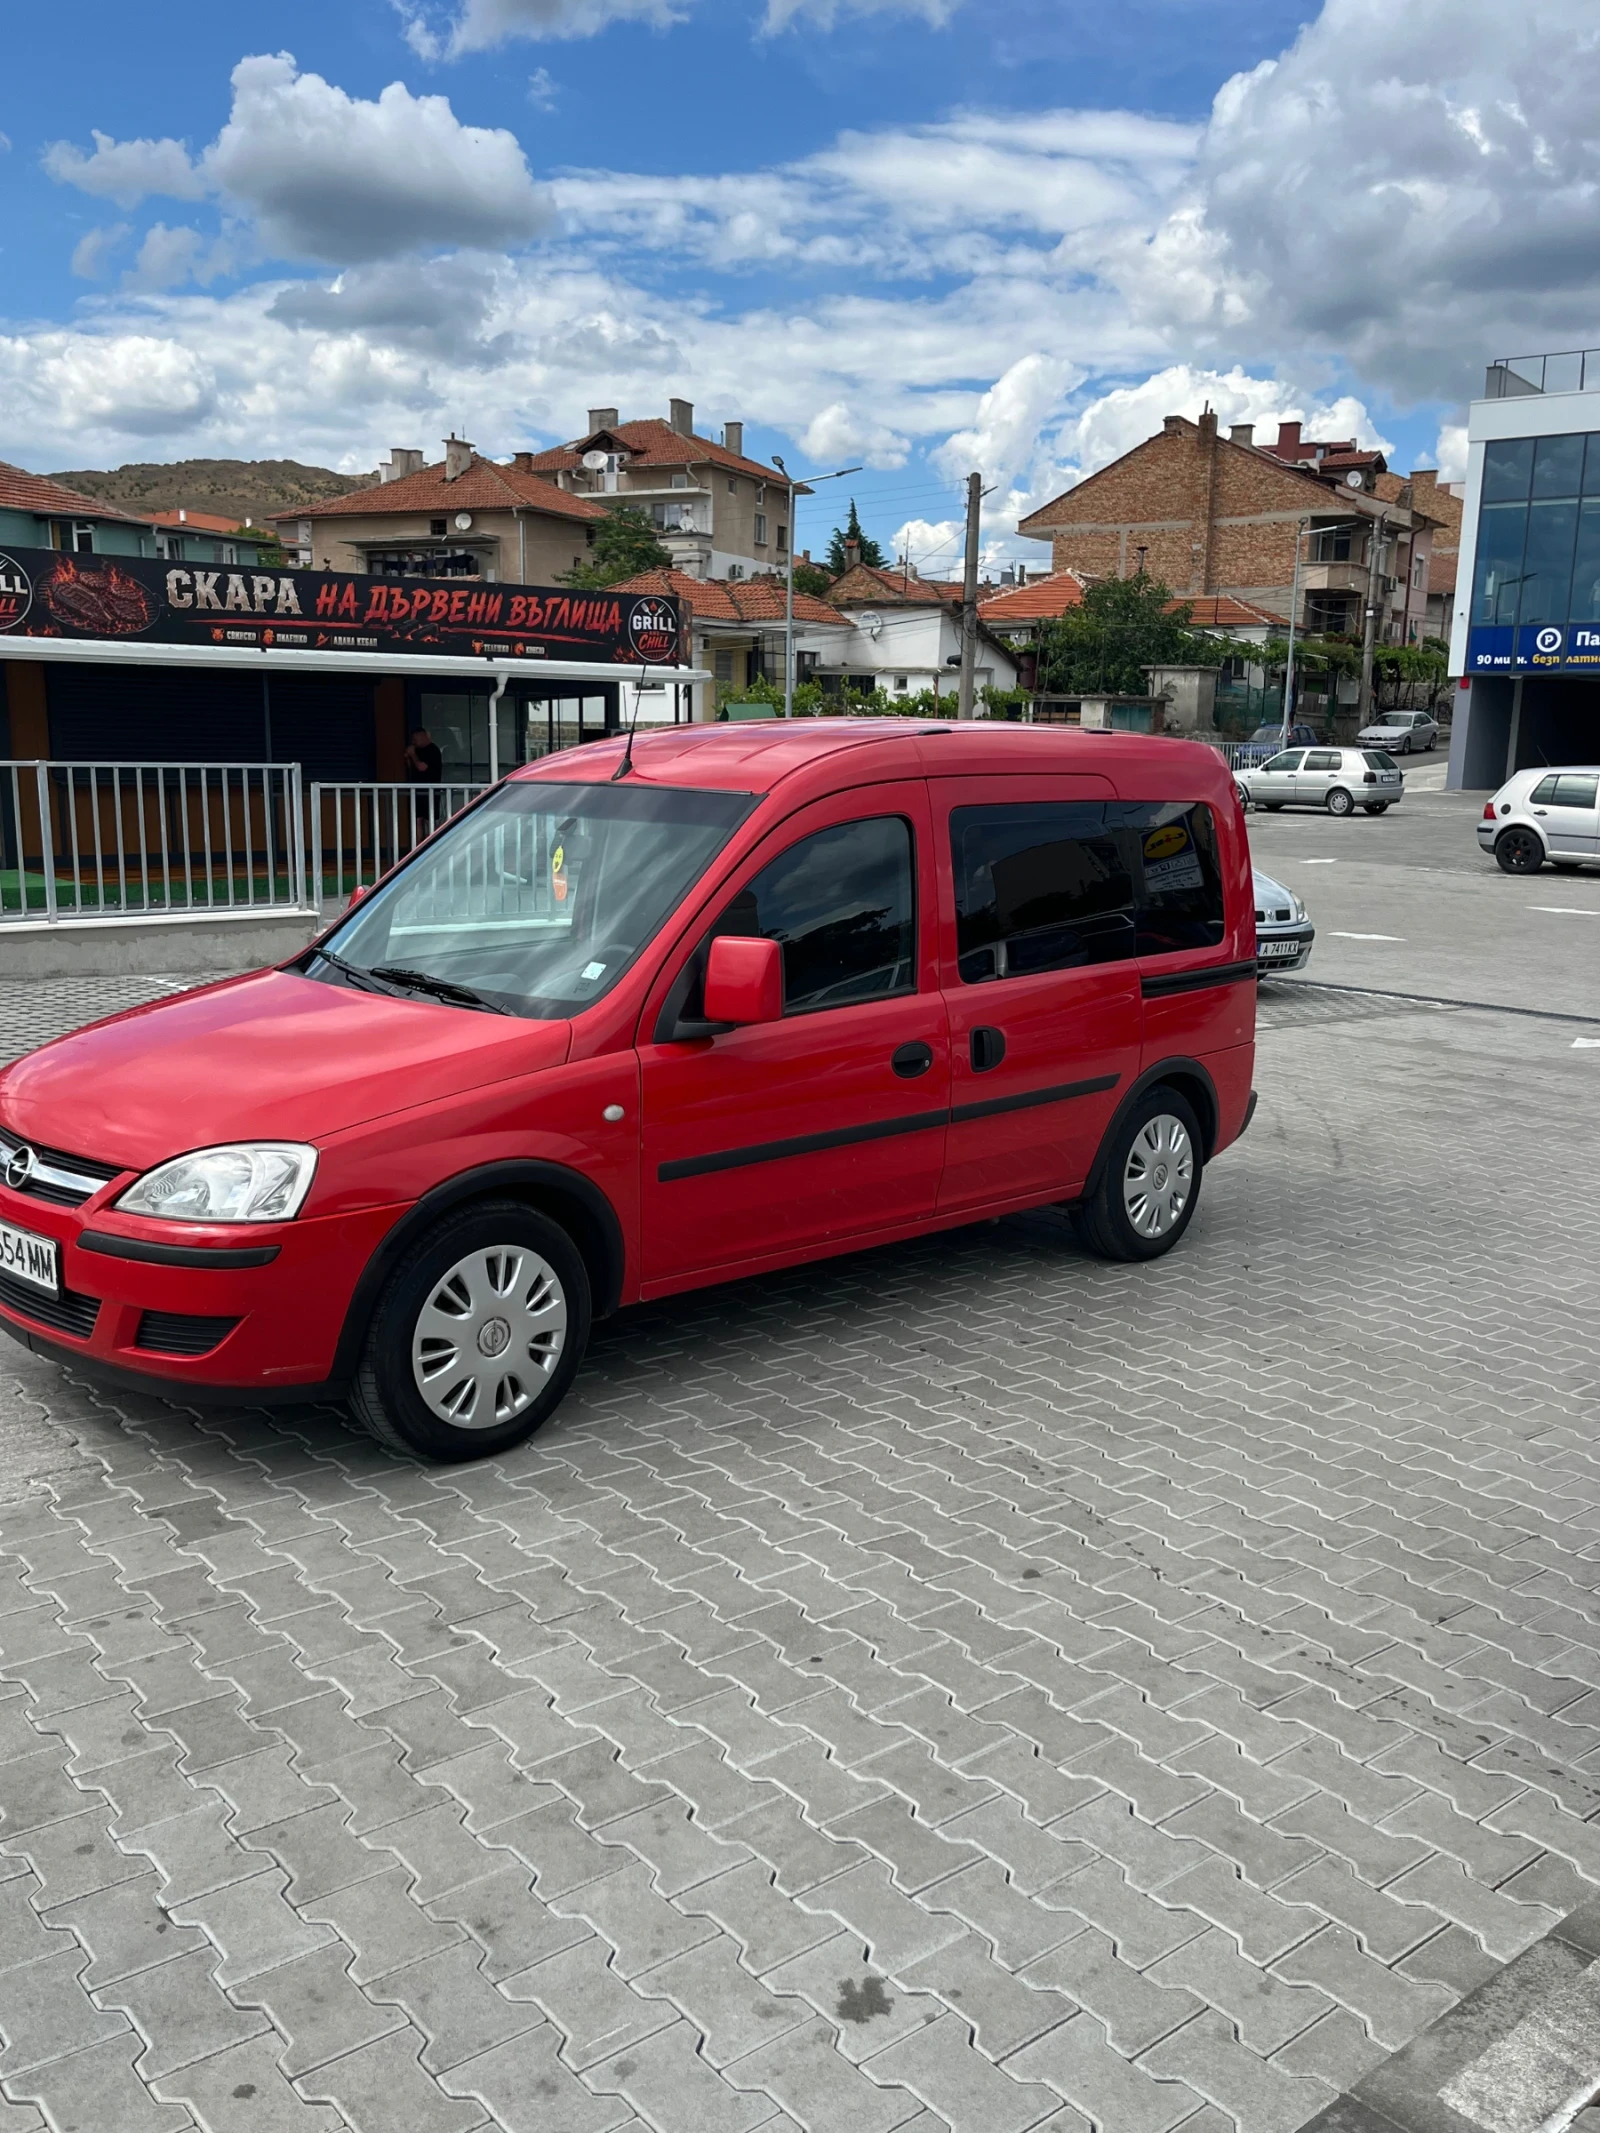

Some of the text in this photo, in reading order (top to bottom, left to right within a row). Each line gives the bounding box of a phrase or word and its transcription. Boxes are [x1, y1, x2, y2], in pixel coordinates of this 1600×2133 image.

[166, 569, 622, 635] СКАРА НА ДЪРВЕНИ ВЪГЛИЩА
[632, 615, 676, 632] GRILL
[276, 633, 308, 644] ПИЛЕШКО
[333, 636, 356, 647] АДАНА
[638, 633, 669, 650] CHILL
[1476, 655, 1492, 665] 90
[1262, 942, 1298, 955] A 7411KX
